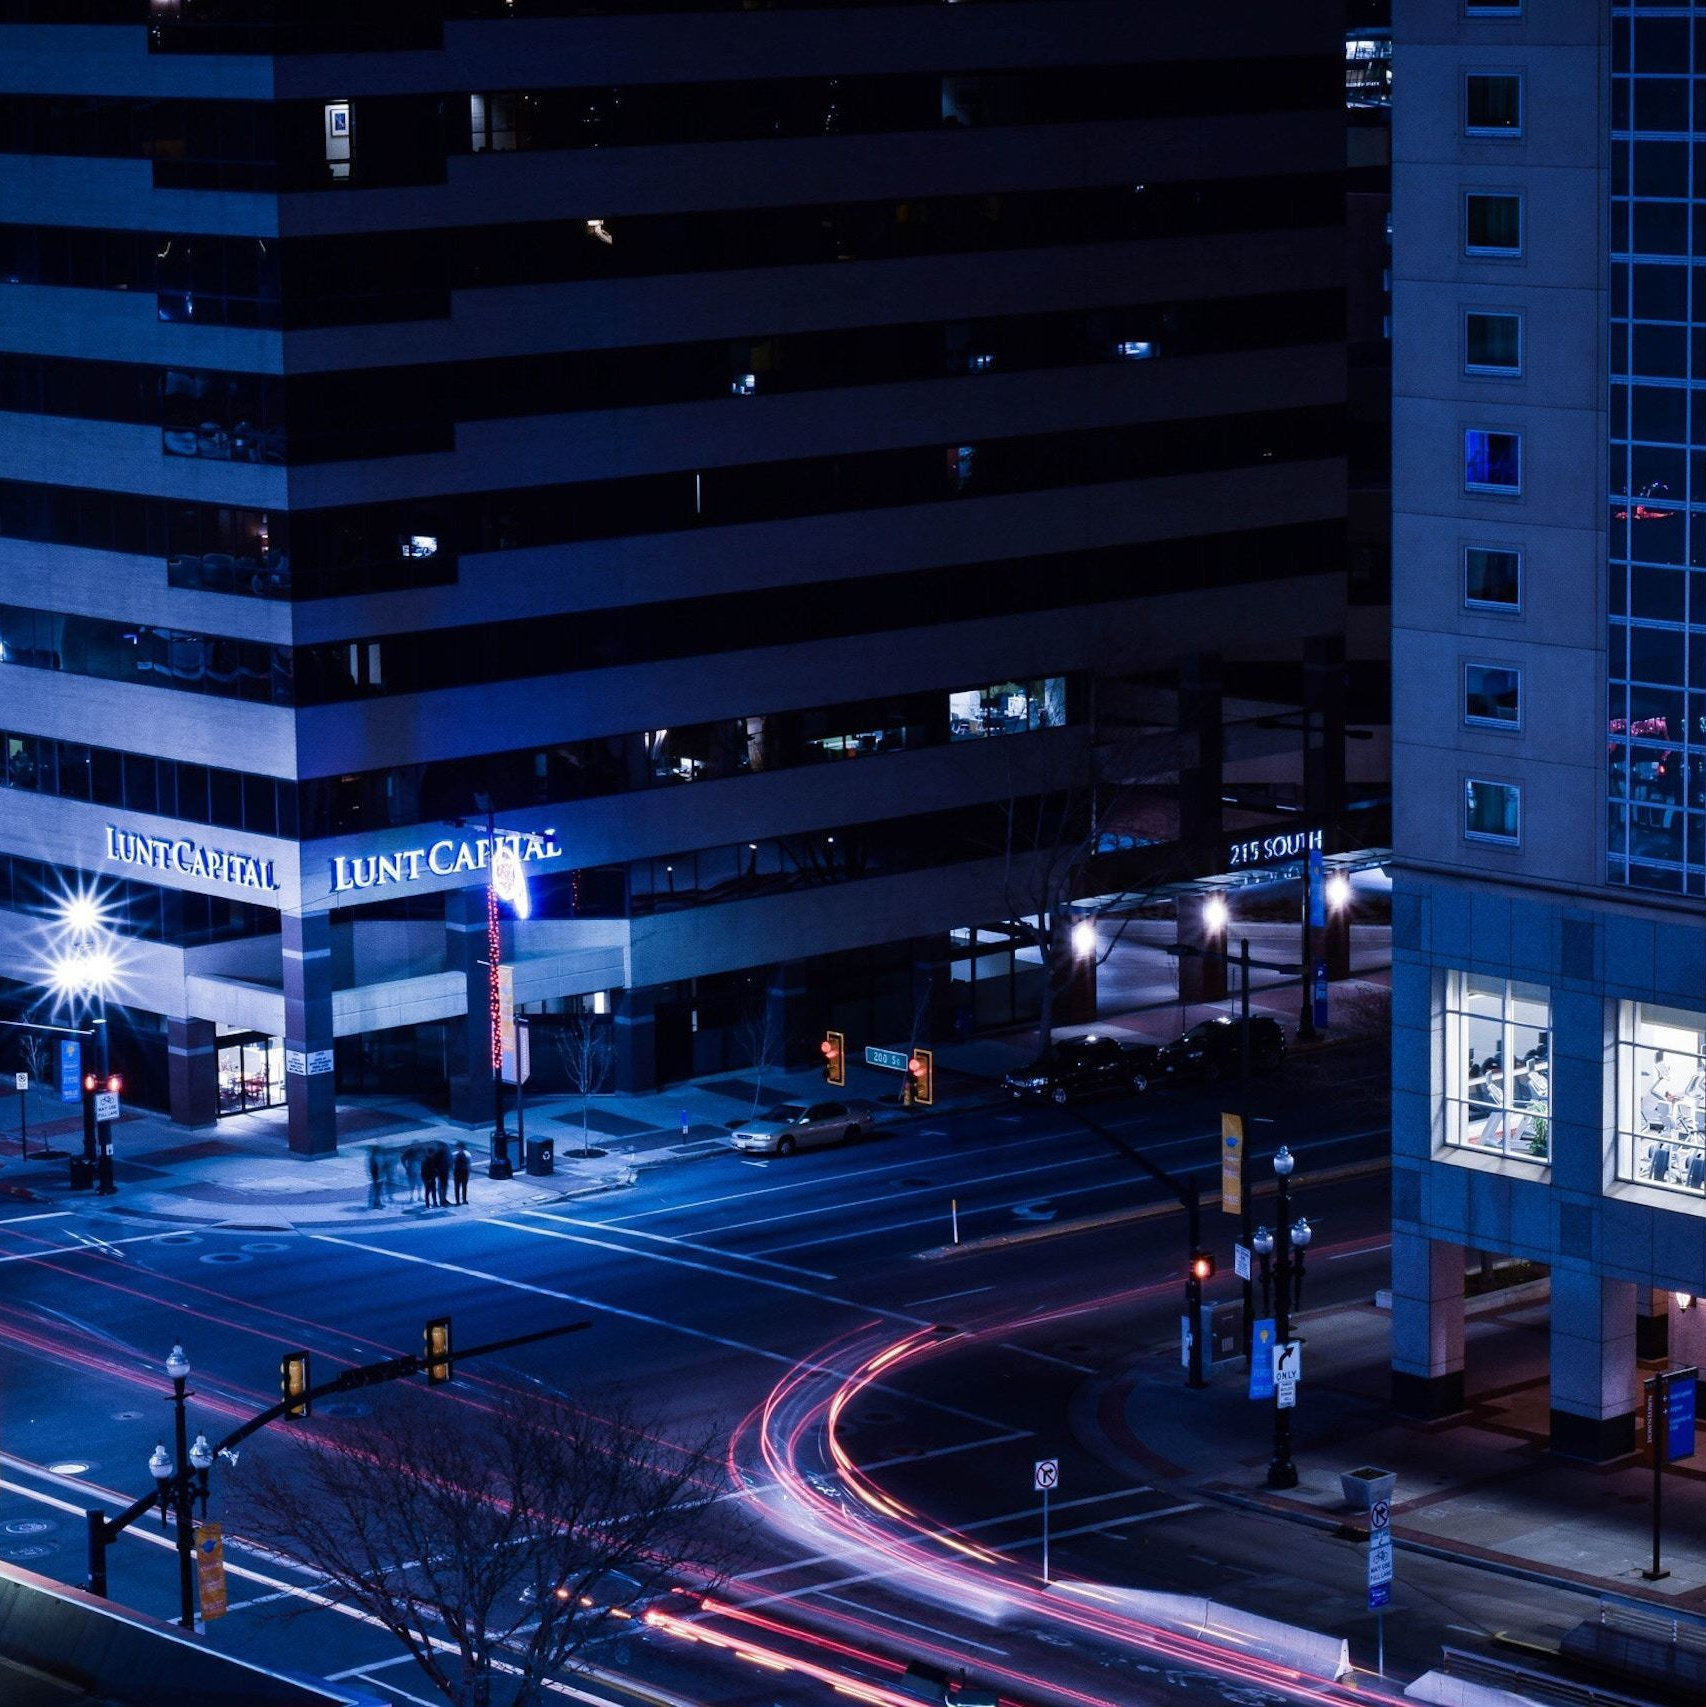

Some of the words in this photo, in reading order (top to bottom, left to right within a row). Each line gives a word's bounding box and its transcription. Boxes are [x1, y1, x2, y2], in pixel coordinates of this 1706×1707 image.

[105, 827, 171, 870] LUNT
[172, 840, 281, 891] CAPITAL
[1229, 840, 1260, 865] 215
[1263, 830, 1323, 859] SOUTH
[333, 849, 425, 892] LUNT
[874, 1052, 888, 1064] 200
[1276, 1370, 1297, 1381] ONLY
